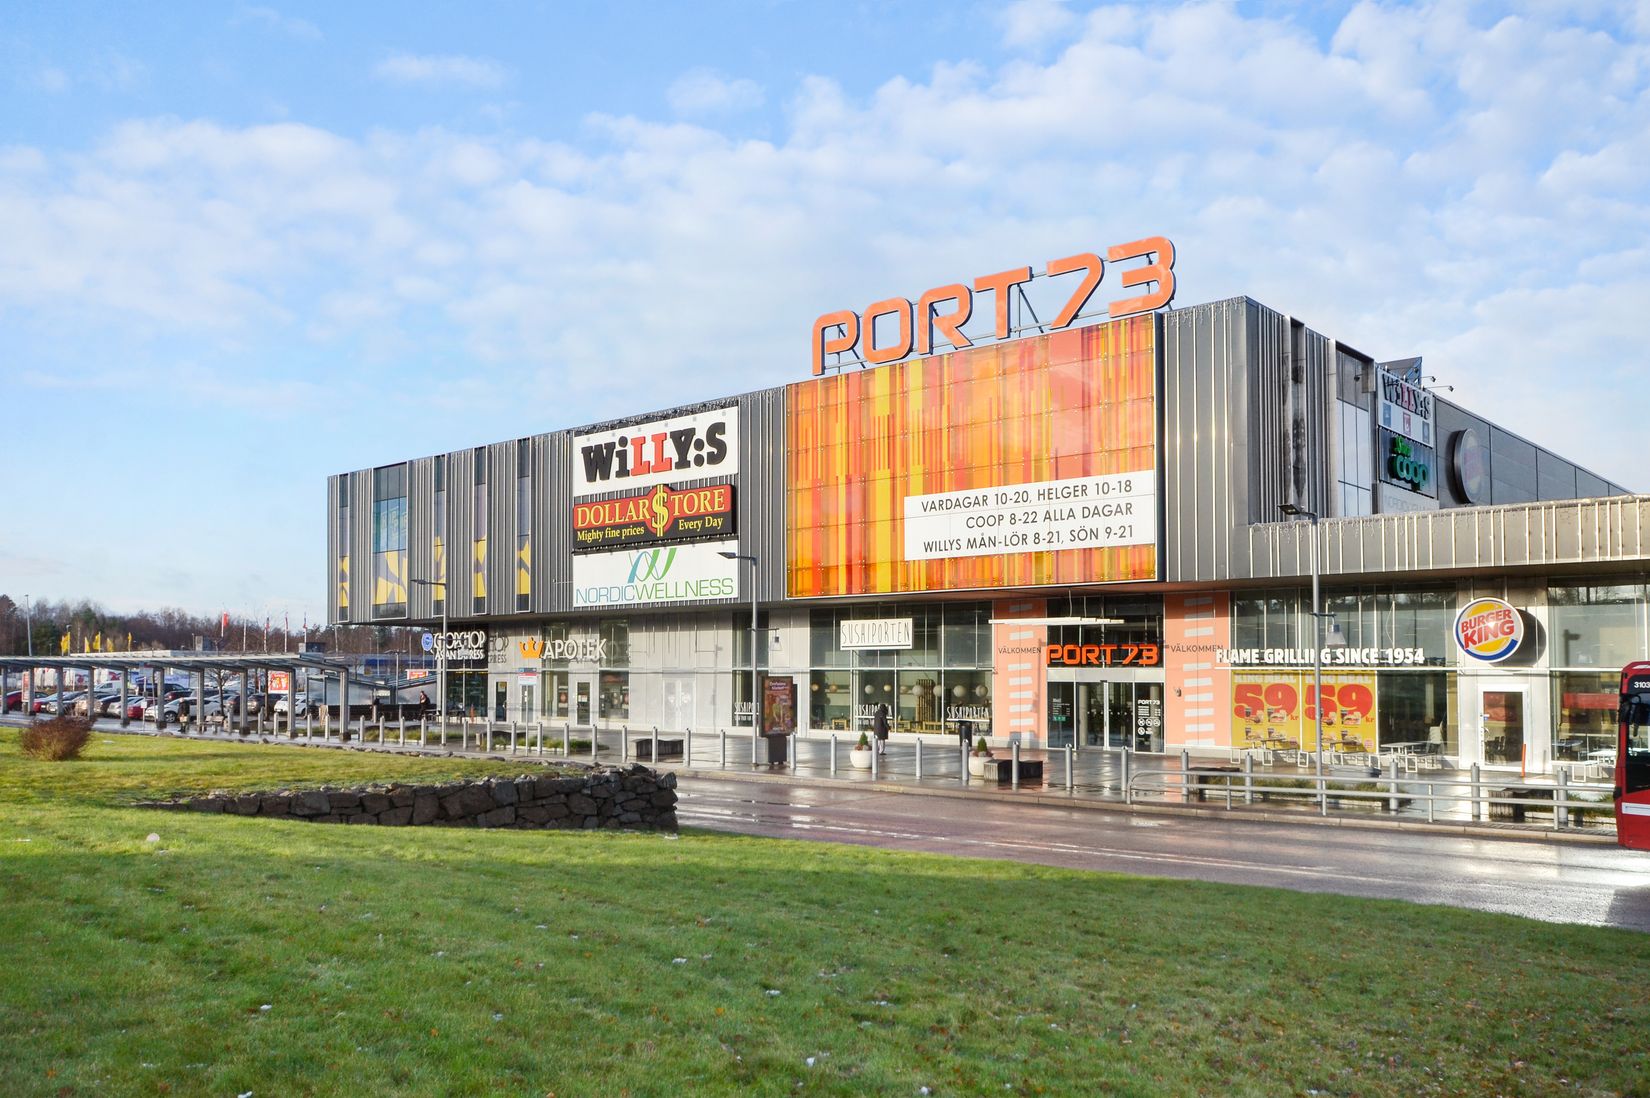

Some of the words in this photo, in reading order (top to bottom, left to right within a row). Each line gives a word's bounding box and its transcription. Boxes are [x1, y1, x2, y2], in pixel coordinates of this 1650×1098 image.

[812, 266, 1032, 376] PORT
[1047, 236, 1176, 329] 73
[921, 495, 989, 512] VARDAGAR
[994, 490, 1032, 507] 10-20,
[1037, 484, 1088, 501] HELGER
[1095, 480, 1133, 495] 10-18
[679, 519, 703, 532] Every
[705, 516, 723, 530] Day
[966, 514, 1004, 529] COOP
[1009, 510, 1038, 526] 8-22
[1043, 507, 1076, 522] ALLA
[1082, 502, 1133, 519] DAGAR
[577, 530, 604, 543] Mighty
[605, 528, 621, 539] fine
[622, 525, 644, 539] prices
[924, 537, 962, 553] WILLYS
[966, 531, 1028, 549] MÅN-LÖR
[1033, 530, 1064, 545] 8-21,
[1069, 526, 1099, 542] SÖN
[1105, 524, 1133, 539] 9-21
[1461, 609, 1512, 633] BURGER
[1464, 620, 1515, 649] KING
[543, 638, 607, 660] APOTEK
[998, 646, 1042, 655] VÄLKOMMEN
[1047, 644, 1118, 665] PORT
[1121, 643, 1159, 665] 73
[1170, 644, 1224, 653] VÄLKOMMEN
[1215, 648, 1260, 664] FLAME
[1335, 648, 1379, 664] SINCE
[1385, 647, 1425, 664] 1954
[1234, 683, 1298, 719] 59
[1304, 684, 1374, 721] 59
